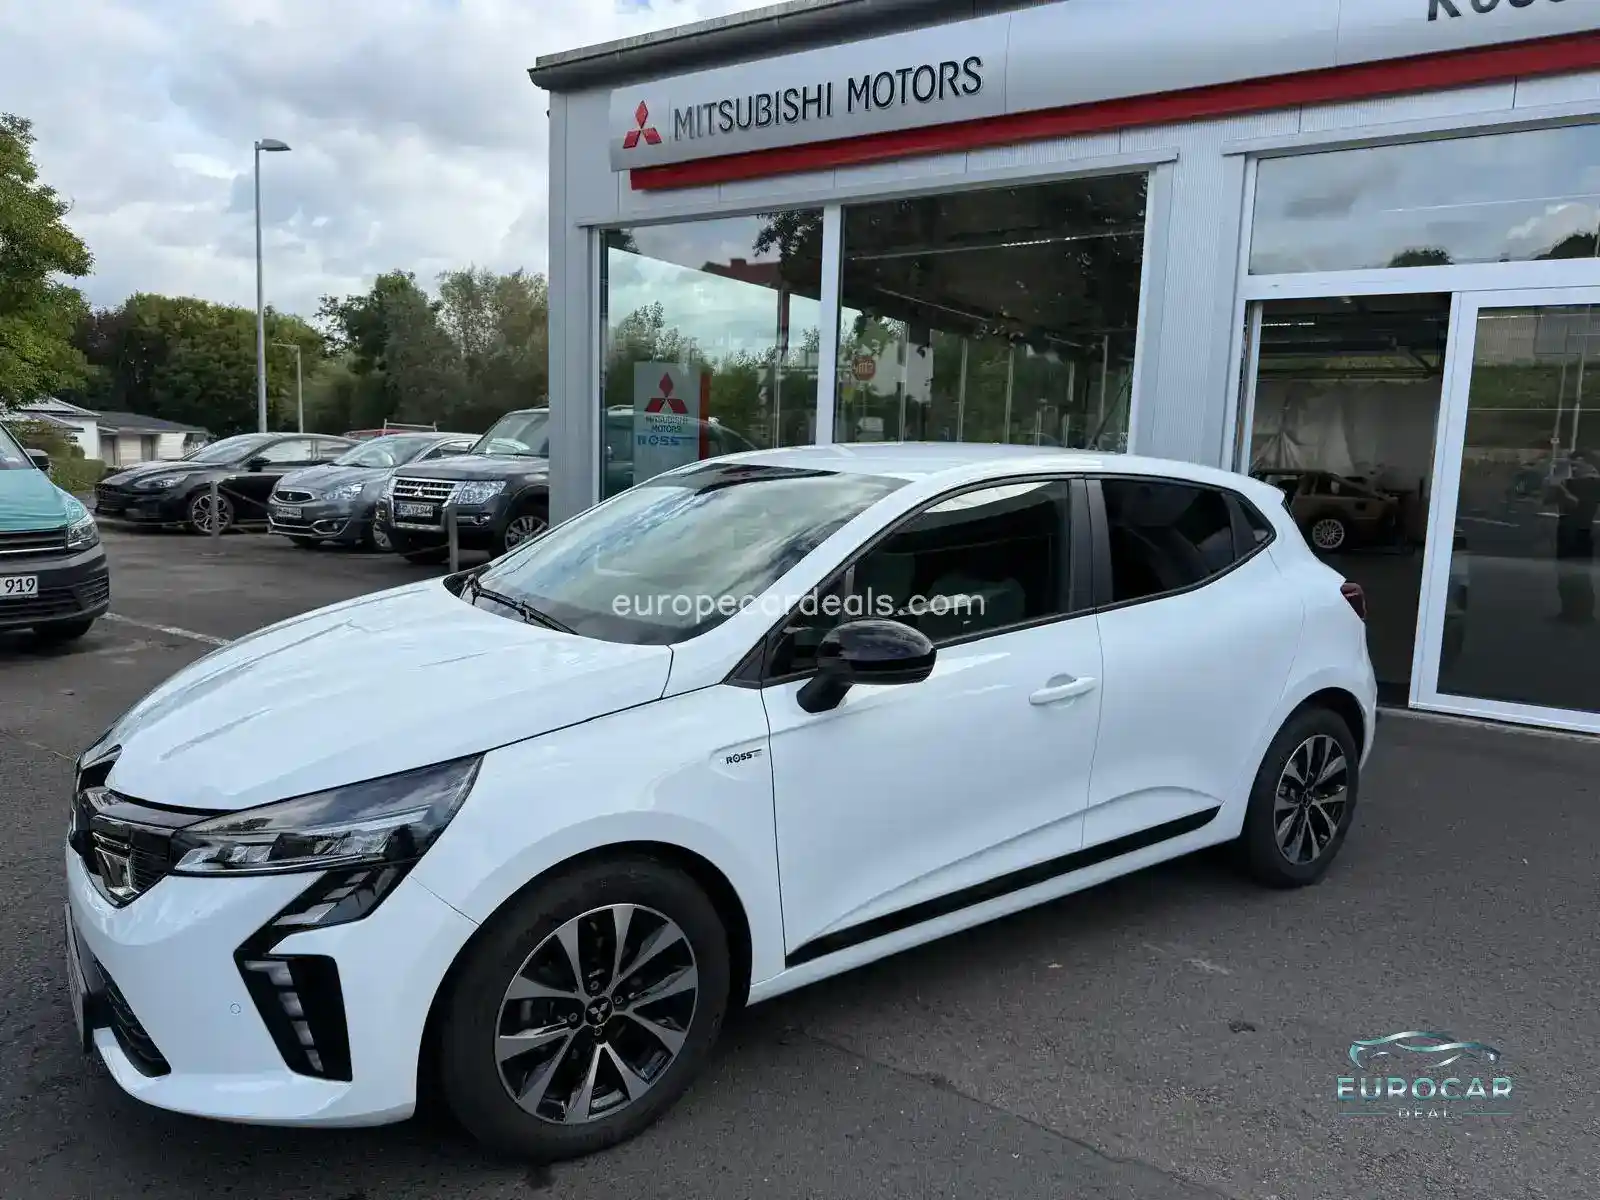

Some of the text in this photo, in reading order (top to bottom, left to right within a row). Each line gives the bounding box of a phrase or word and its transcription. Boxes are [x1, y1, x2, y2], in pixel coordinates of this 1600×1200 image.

[674, 56, 983, 141] MITSUBISHI MOTORS
[5, 578, 35, 593] 919
[726, 752, 753, 764] ROSS
